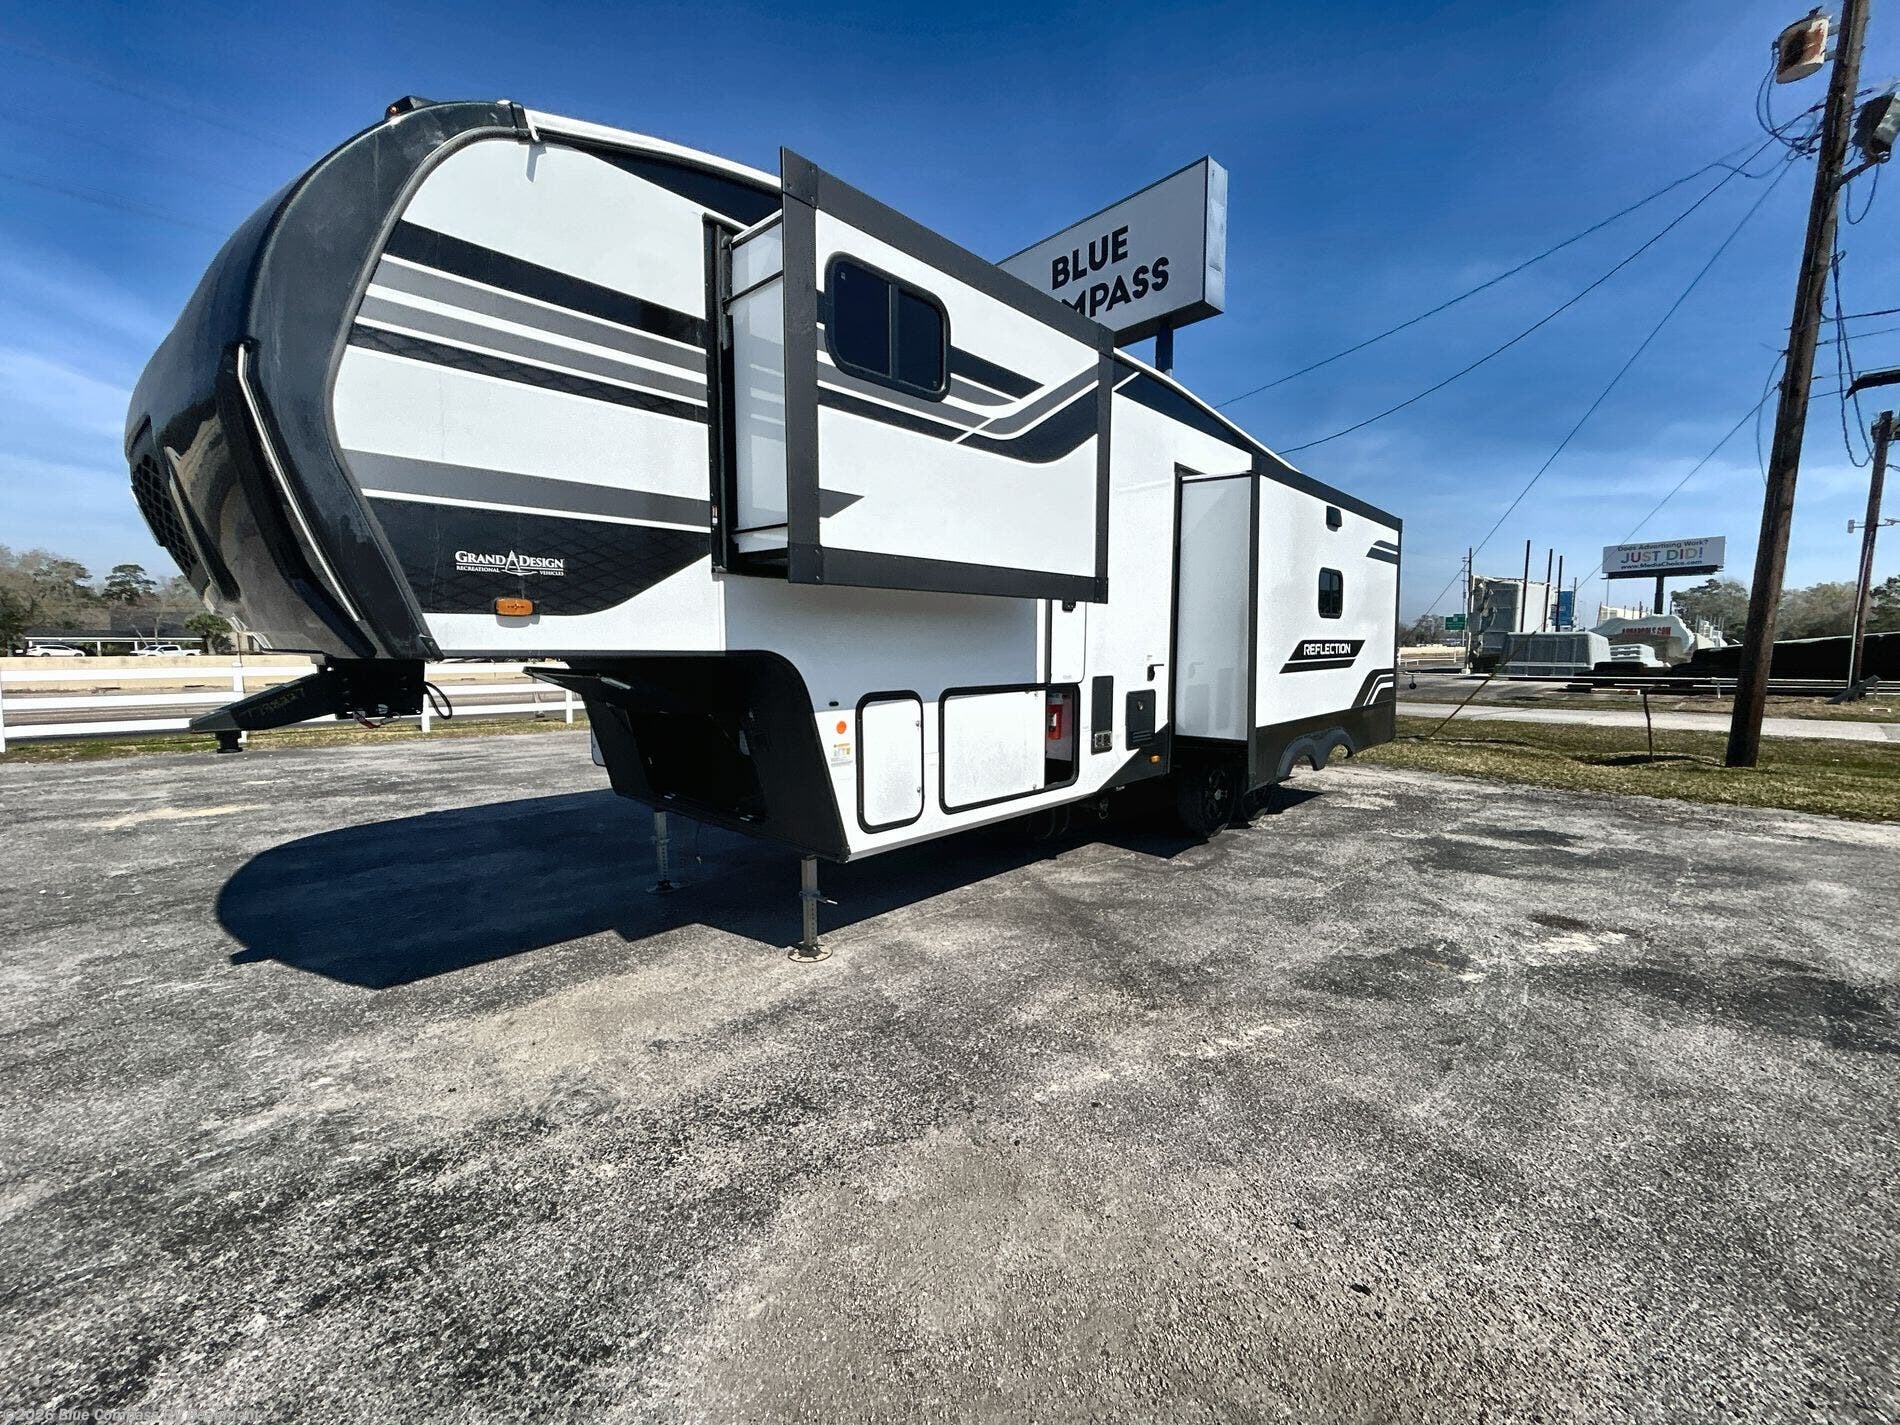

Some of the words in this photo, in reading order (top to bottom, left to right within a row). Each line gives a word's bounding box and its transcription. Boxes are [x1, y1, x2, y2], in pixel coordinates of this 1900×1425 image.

[1052, 225, 1128, 290] BLUE
[1062, 257, 1169, 318] MPASS
[1639, 542, 1682, 550] Advertising
[1684, 539, 1708, 547] Work?
[455, 550, 505, 565] GRAND
[518, 555, 564, 568] DESIGN
[1620, 550, 1660, 564] JUST
[1666, 547, 1703, 561] DID!
[456, 565, 500, 573] RECREATIONAL
[1303, 643, 1351, 656] REFLECTION
